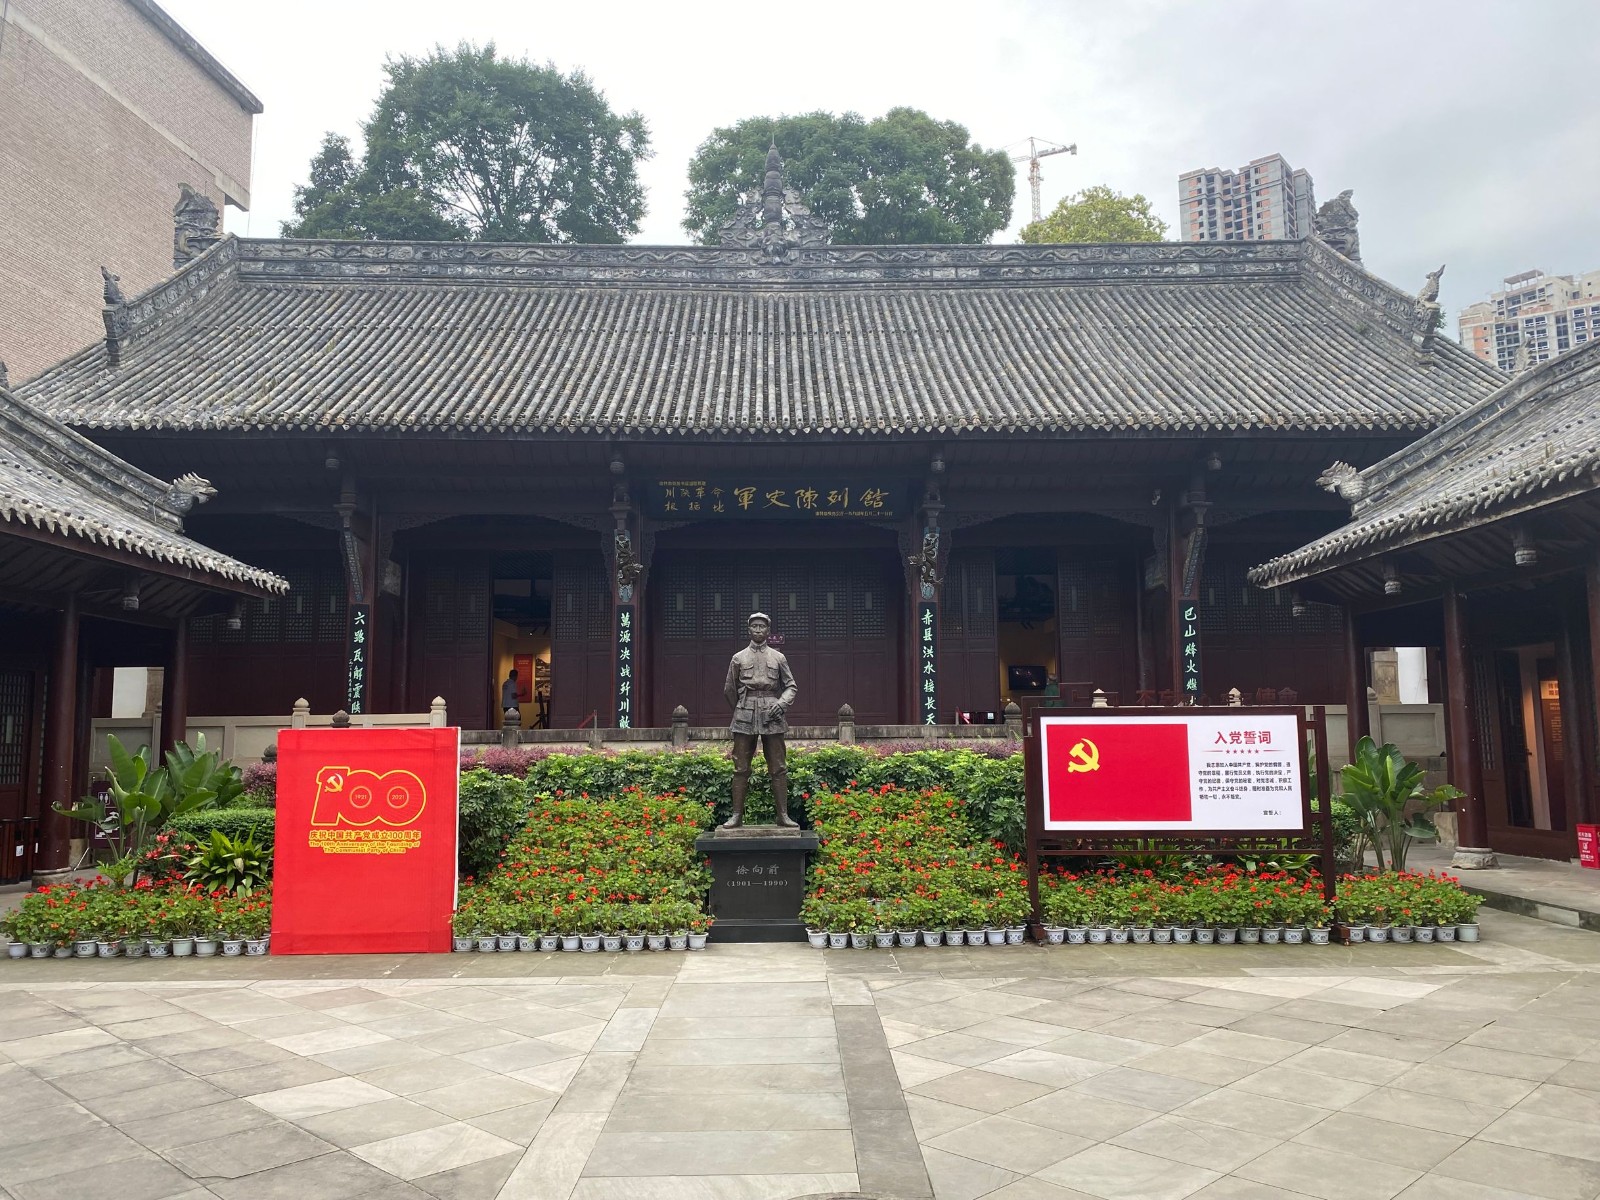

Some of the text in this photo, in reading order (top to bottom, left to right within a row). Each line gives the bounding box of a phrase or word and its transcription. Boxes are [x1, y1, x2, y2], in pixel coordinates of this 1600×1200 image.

[1214, 730, 1272, 745] 入党誓词
[310, 830, 421, 840] 庆祝中国共产党成立100周年
[735, 864, 780, 875] 徐向前
